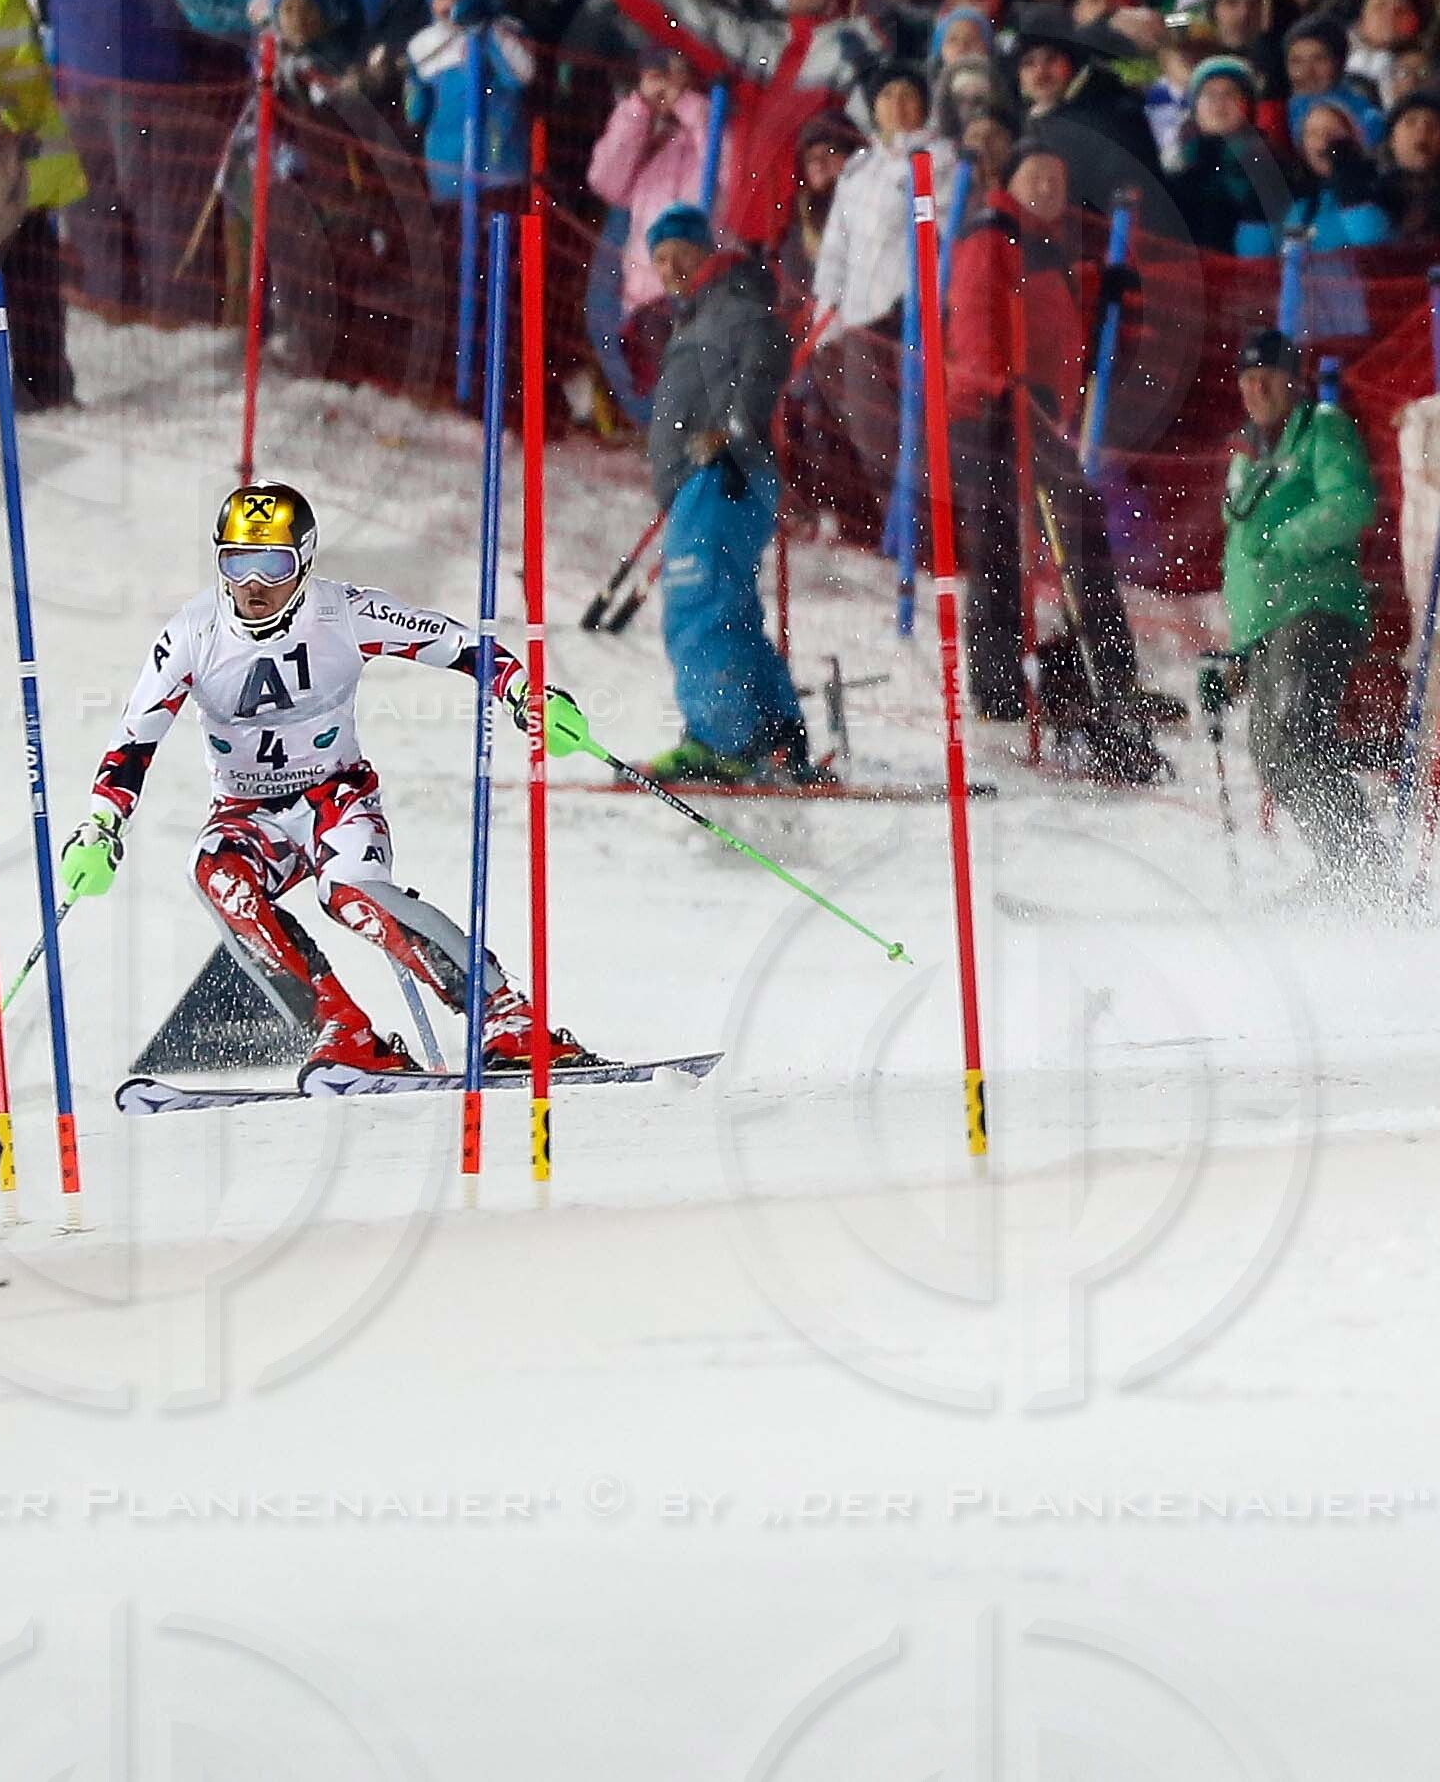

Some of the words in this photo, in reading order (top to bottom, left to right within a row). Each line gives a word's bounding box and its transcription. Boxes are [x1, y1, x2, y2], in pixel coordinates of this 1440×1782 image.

[378, 605, 447, 634] Schöffel
[153, 630, 172, 672] A1
[234, 643, 312, 717] A1
[257, 730, 288, 769] 4
[230, 764, 325, 781] SCHLADMING
[362, 845, 385, 863] A1
